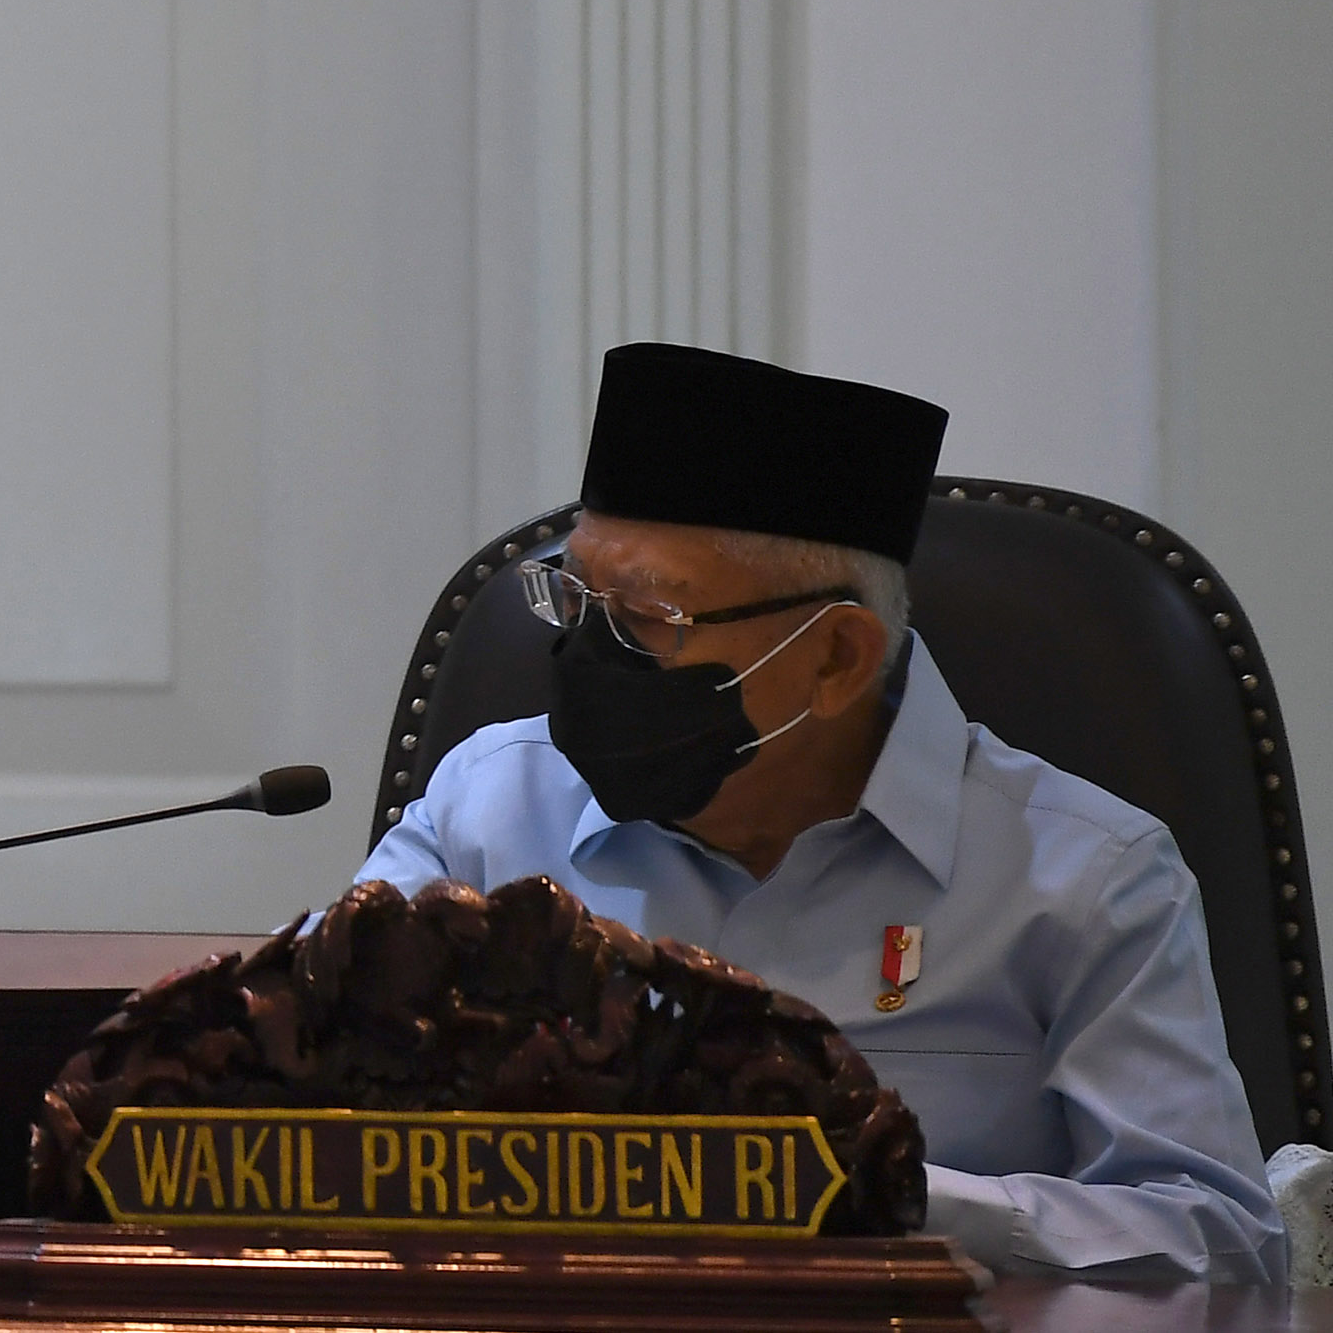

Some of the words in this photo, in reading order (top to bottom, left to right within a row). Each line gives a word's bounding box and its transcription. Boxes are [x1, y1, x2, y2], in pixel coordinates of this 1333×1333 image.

[133, 1124, 339, 1211] WAKIL
[363, 1127, 702, 1219] PRESIDEN
[735, 1134, 796, 1220] RI
